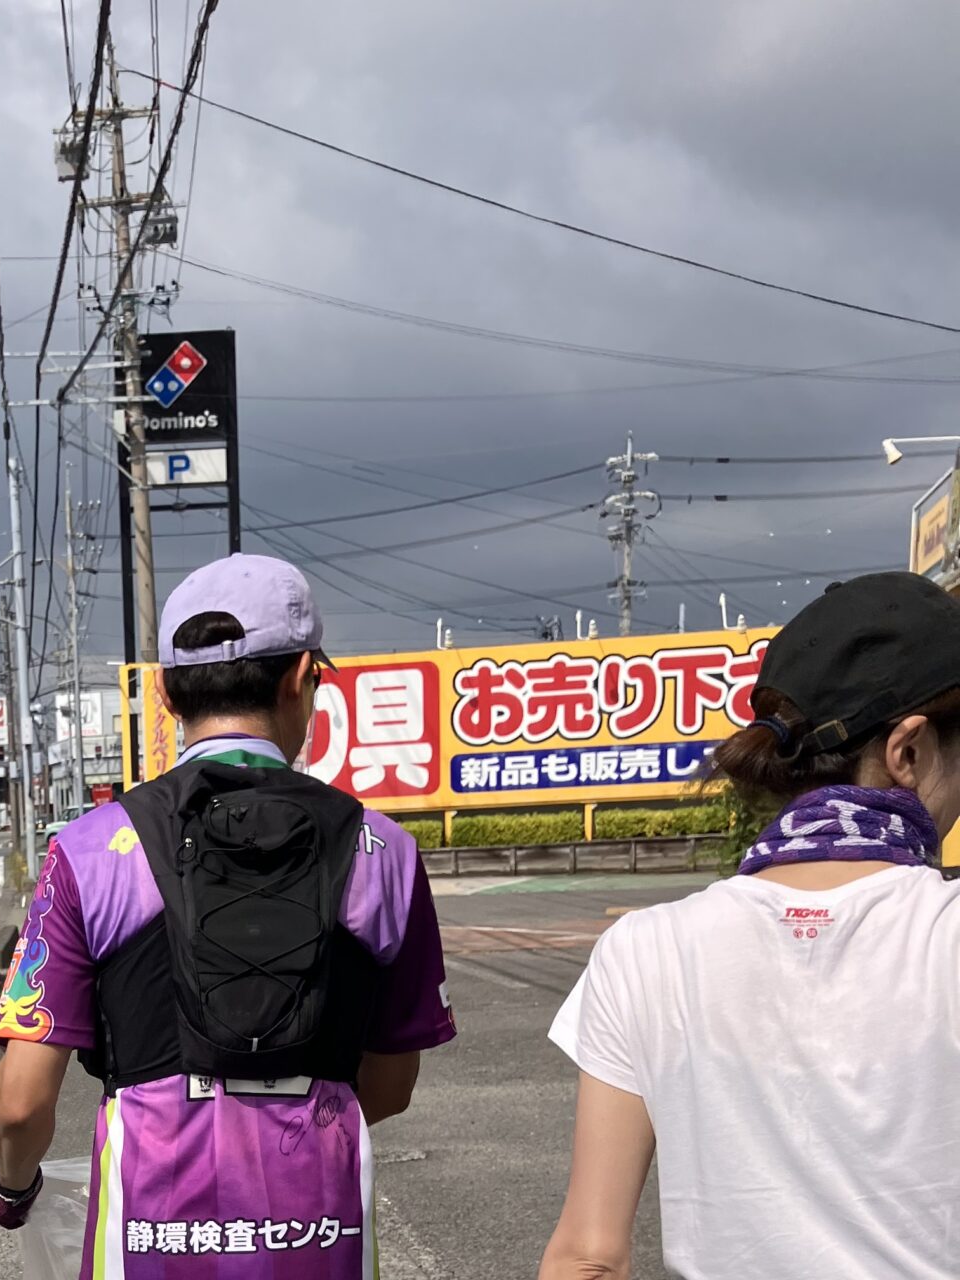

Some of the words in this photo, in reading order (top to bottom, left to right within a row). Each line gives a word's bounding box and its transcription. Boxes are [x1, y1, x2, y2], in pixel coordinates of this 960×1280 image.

[168, 455, 191, 480] P
[127, 1217, 361, 1253] 静環検査センター
